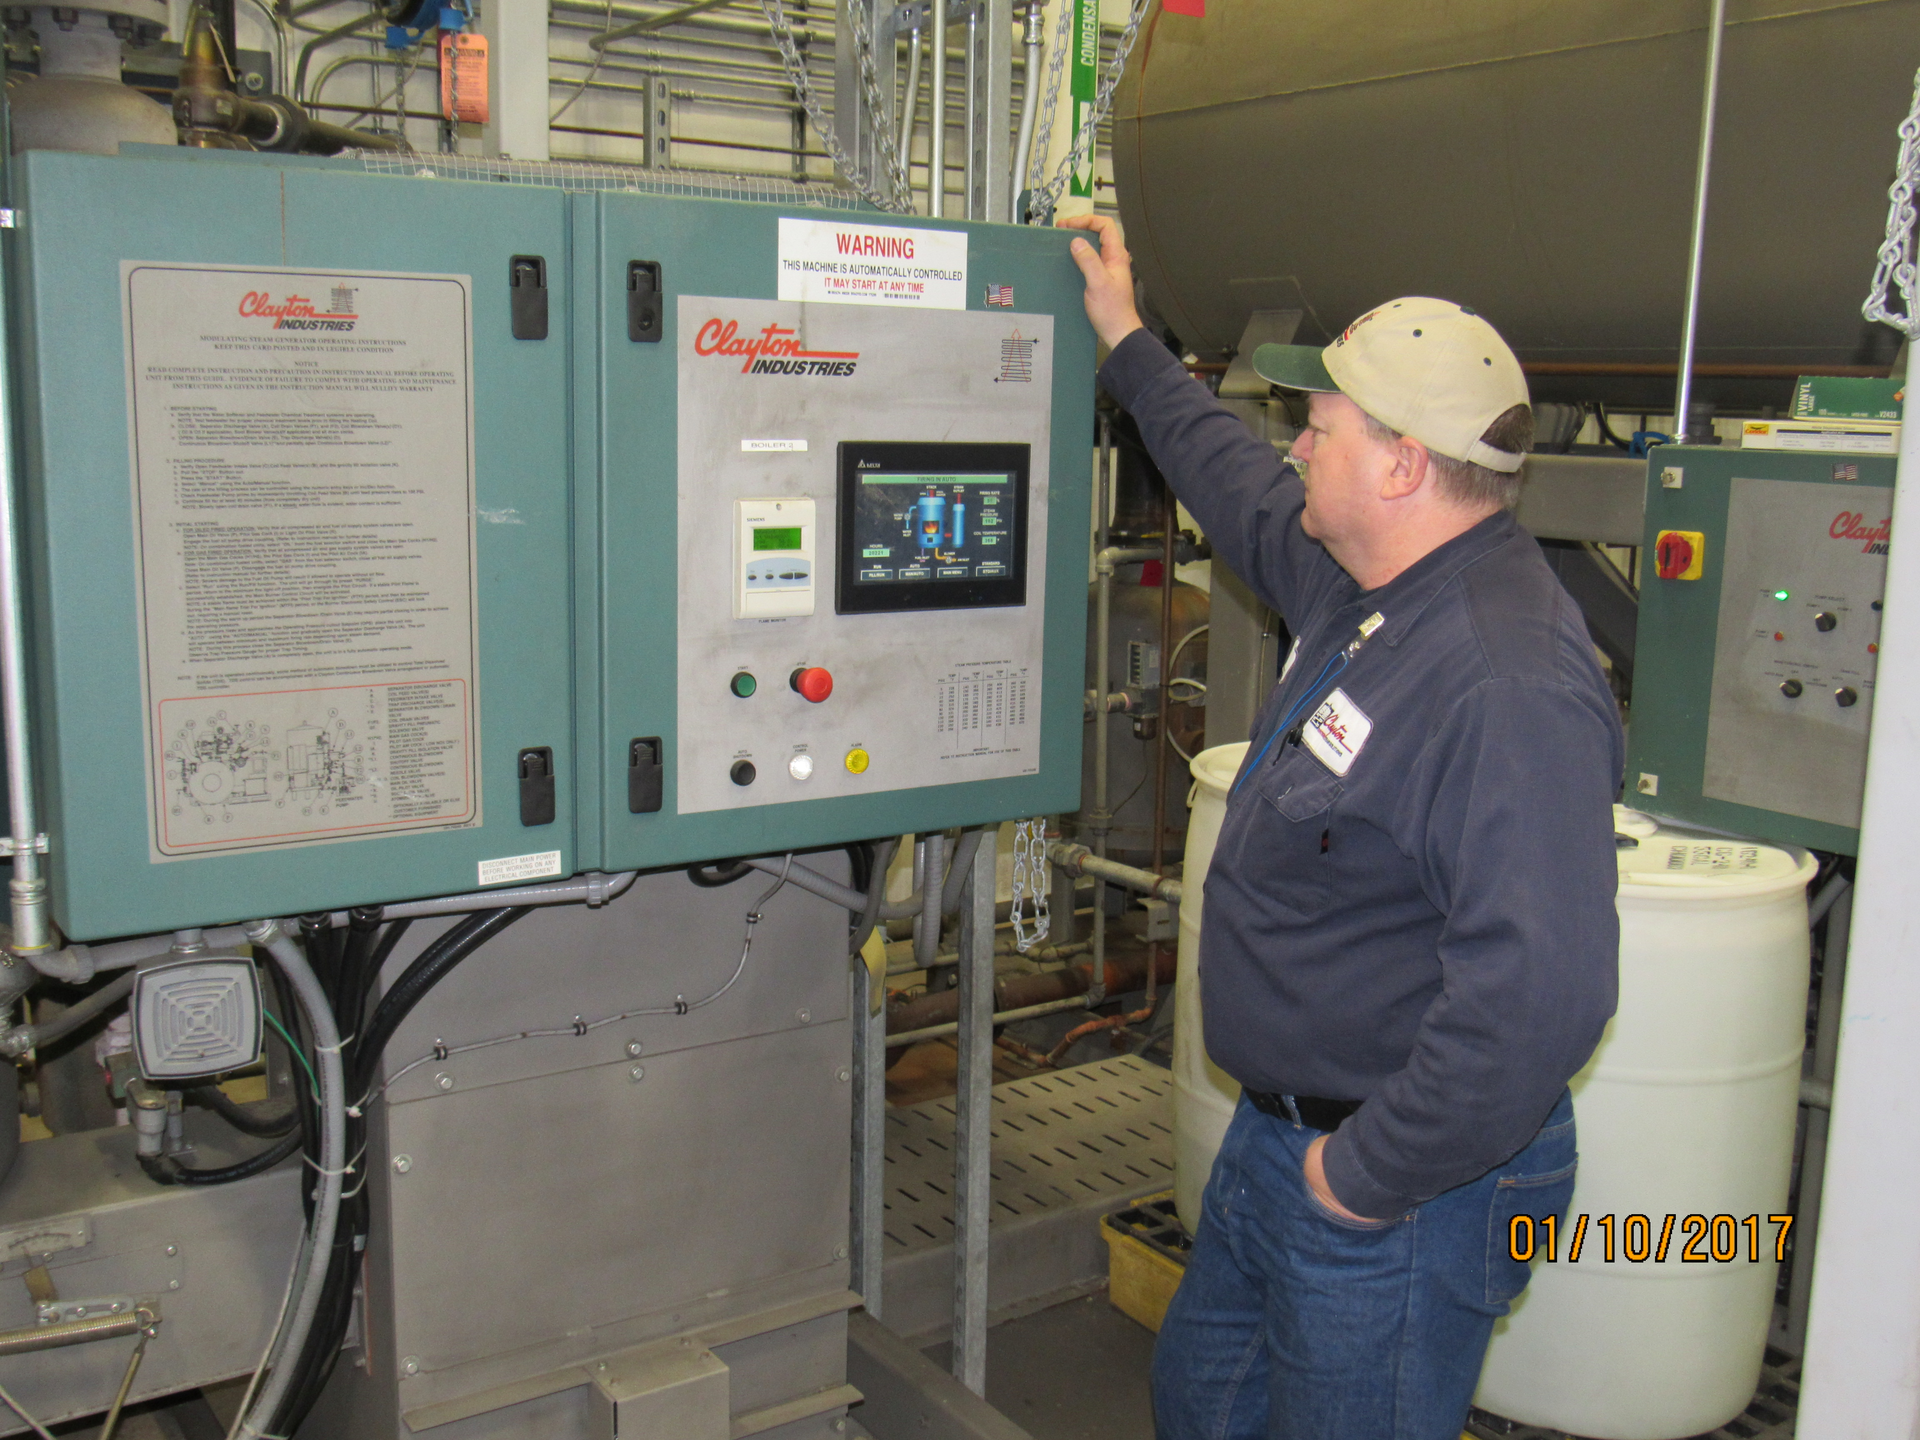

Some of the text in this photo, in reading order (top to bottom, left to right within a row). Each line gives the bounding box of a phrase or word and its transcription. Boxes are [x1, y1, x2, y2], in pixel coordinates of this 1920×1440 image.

[836, 233, 915, 260] WARNING
[783, 260, 963, 281] THIS MACHINE IS AUTOMATICALLY CONTROLLED
[824, 277, 924, 293] IT MAY START AT ANY TIME
[238, 291, 359, 330] Clayton
[278, 320, 355, 331] INDUSTRIES
[694, 318, 860, 374] Clayton
[751, 360, 857, 376] INDUSTRIES
[1797, 382, 1812, 411] VINYL
[482, 853, 556, 869] DISCONNECT MAIN POWER
[482, 867, 503, 875] BEFORE
[505, 862, 533, 872] WORKING
[544, 859, 556, 867] ANY
[484, 866, 554, 883] ELECTRICAL COMPONENT
